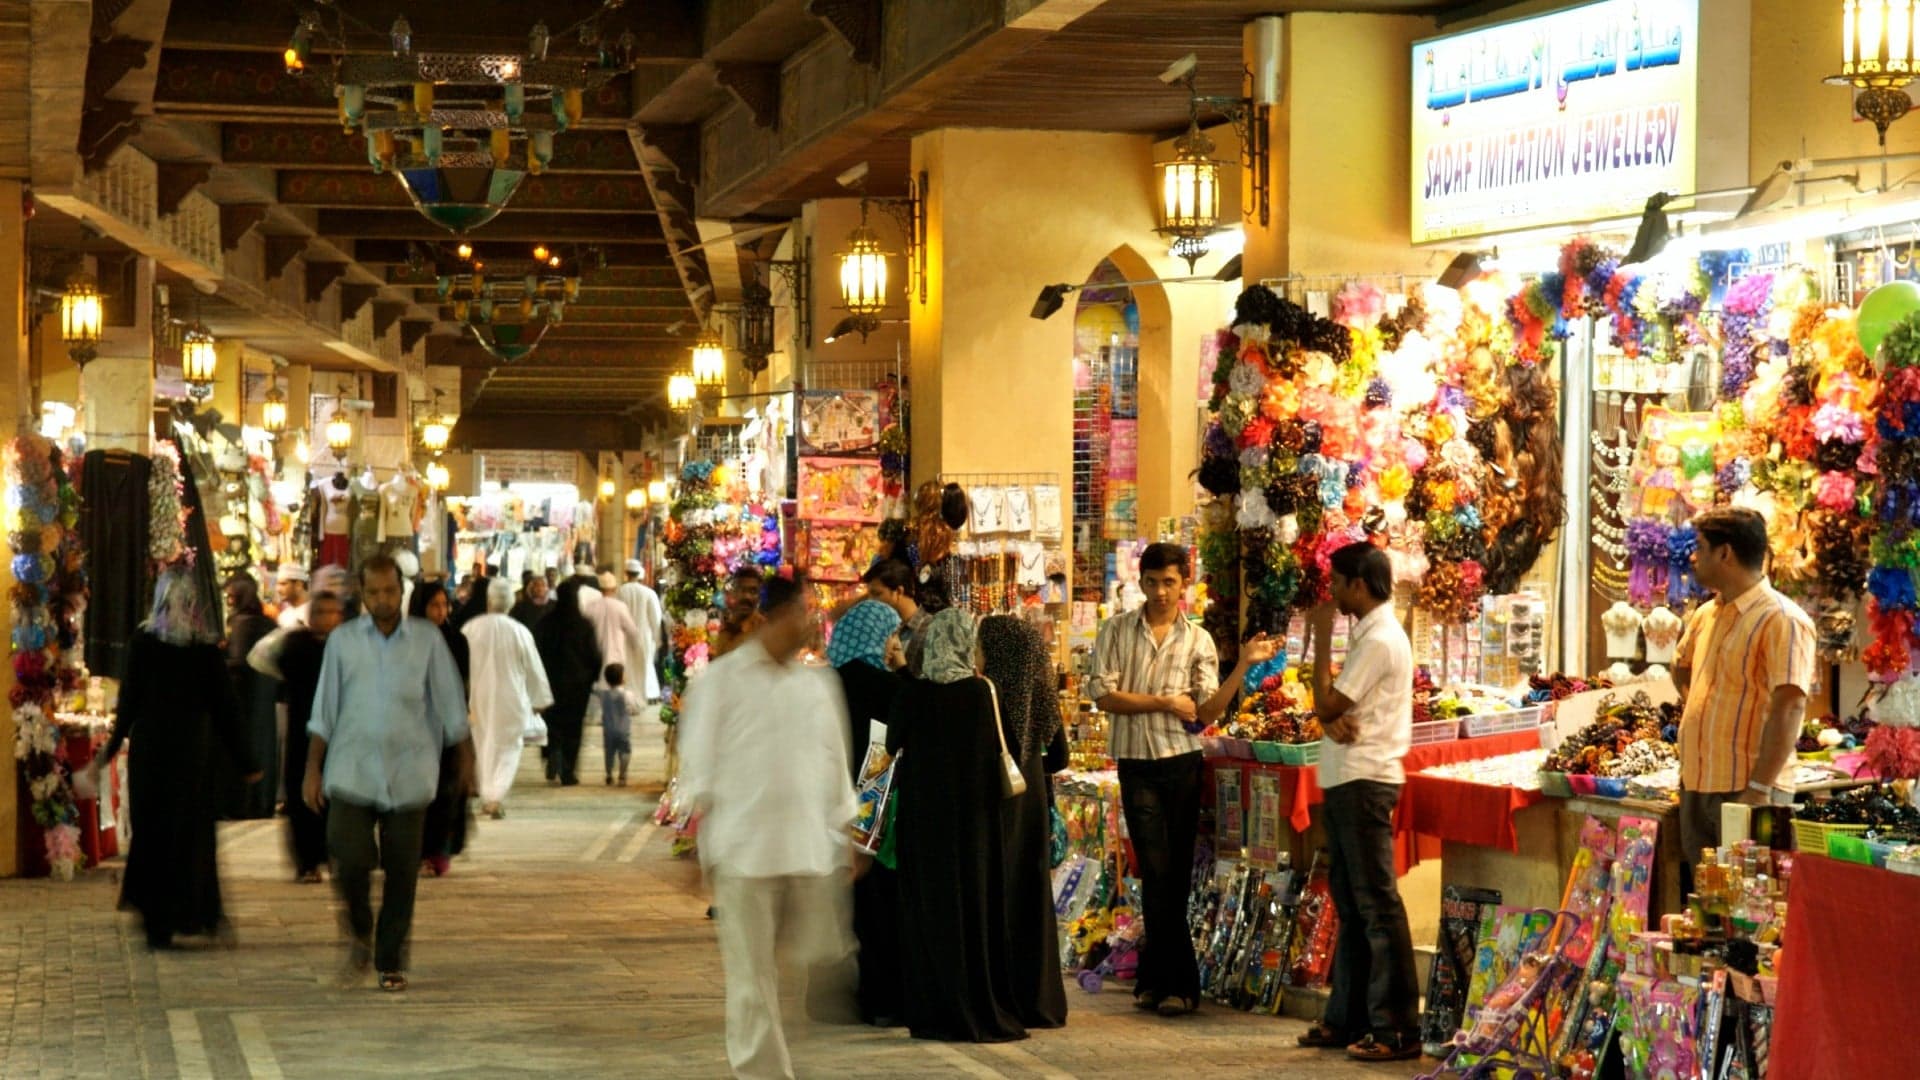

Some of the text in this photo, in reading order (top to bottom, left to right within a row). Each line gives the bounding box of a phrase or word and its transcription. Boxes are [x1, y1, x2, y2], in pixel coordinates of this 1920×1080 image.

[1424, 101, 1680, 200] SADAF IMITATION JEWELLERY
